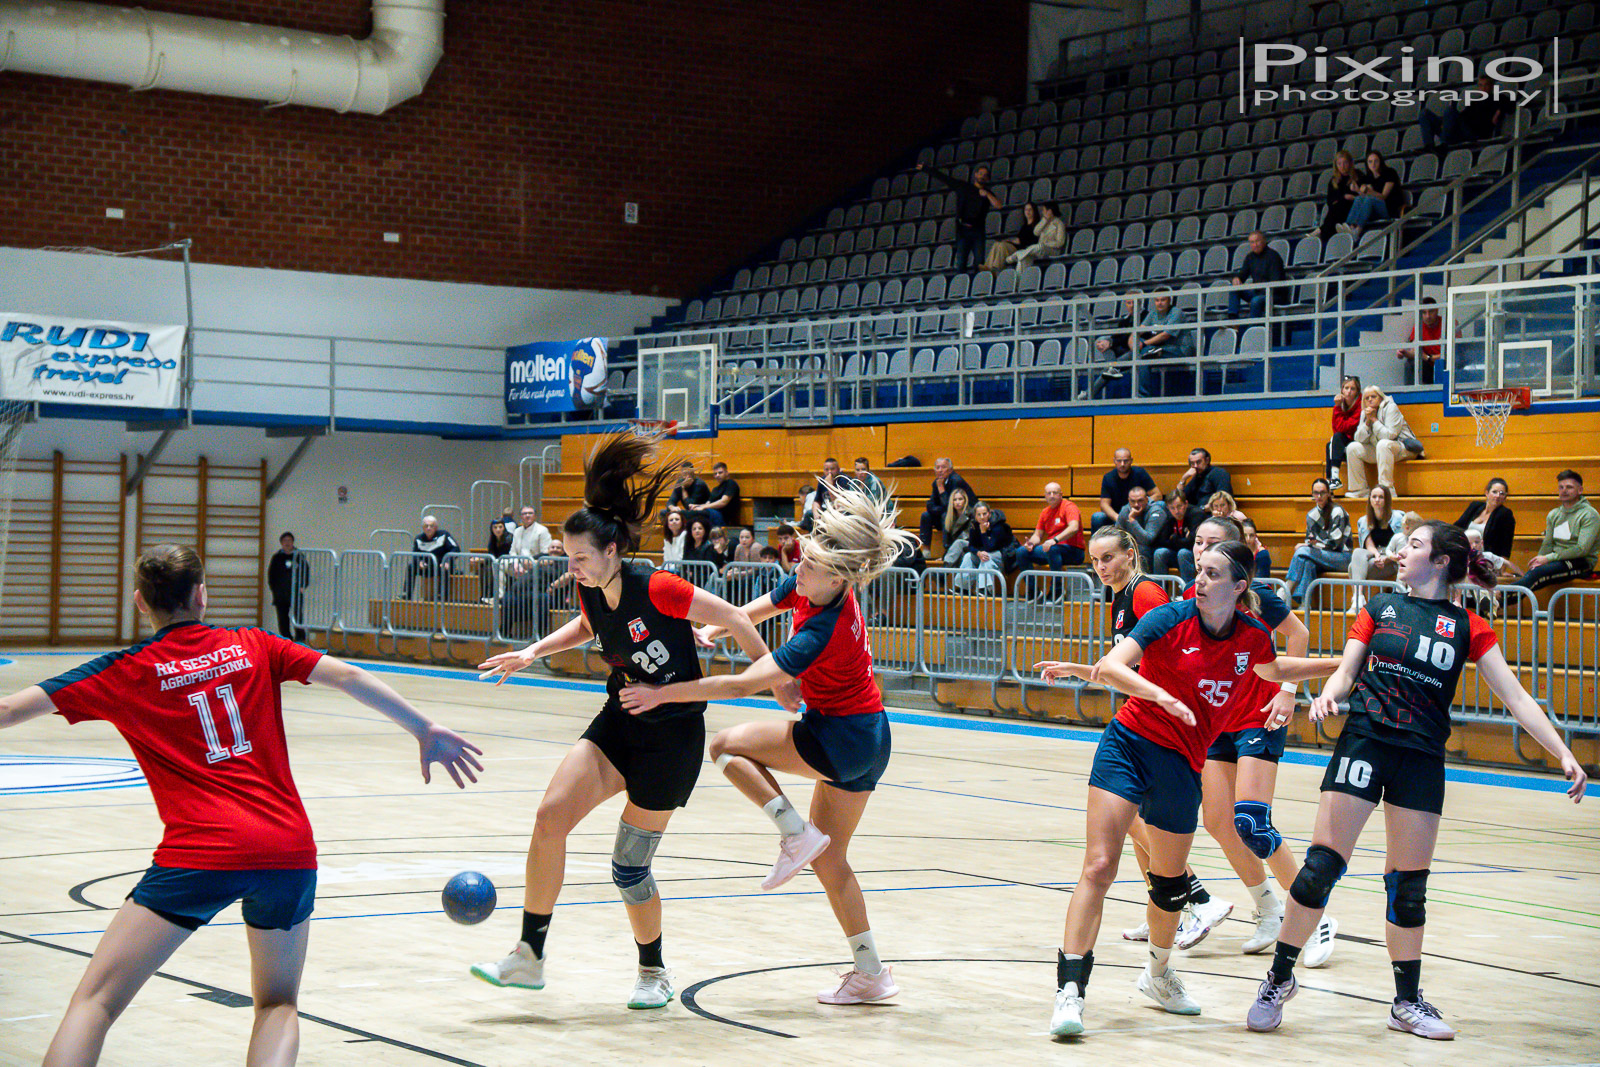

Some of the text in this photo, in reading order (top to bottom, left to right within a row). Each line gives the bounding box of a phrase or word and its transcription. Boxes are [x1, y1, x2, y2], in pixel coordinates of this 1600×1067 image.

[1, 321, 150, 352] RUDI
[32, 363, 130, 385] travel
[51, 351, 177, 370] express
[510, 353, 566, 384] molten
[42, 387, 135, 401] www.rudi-express.hr
[154, 644, 247, 677] RK SESVETE
[631, 639, 670, 675] 29
[1414, 634, 1456, 671] 10
[160, 657, 253, 692] AGROPROTEINKA
[1197, 678, 1233, 707] 35
[187, 683, 253, 764] 11
[1334, 756, 1373, 789] 10
